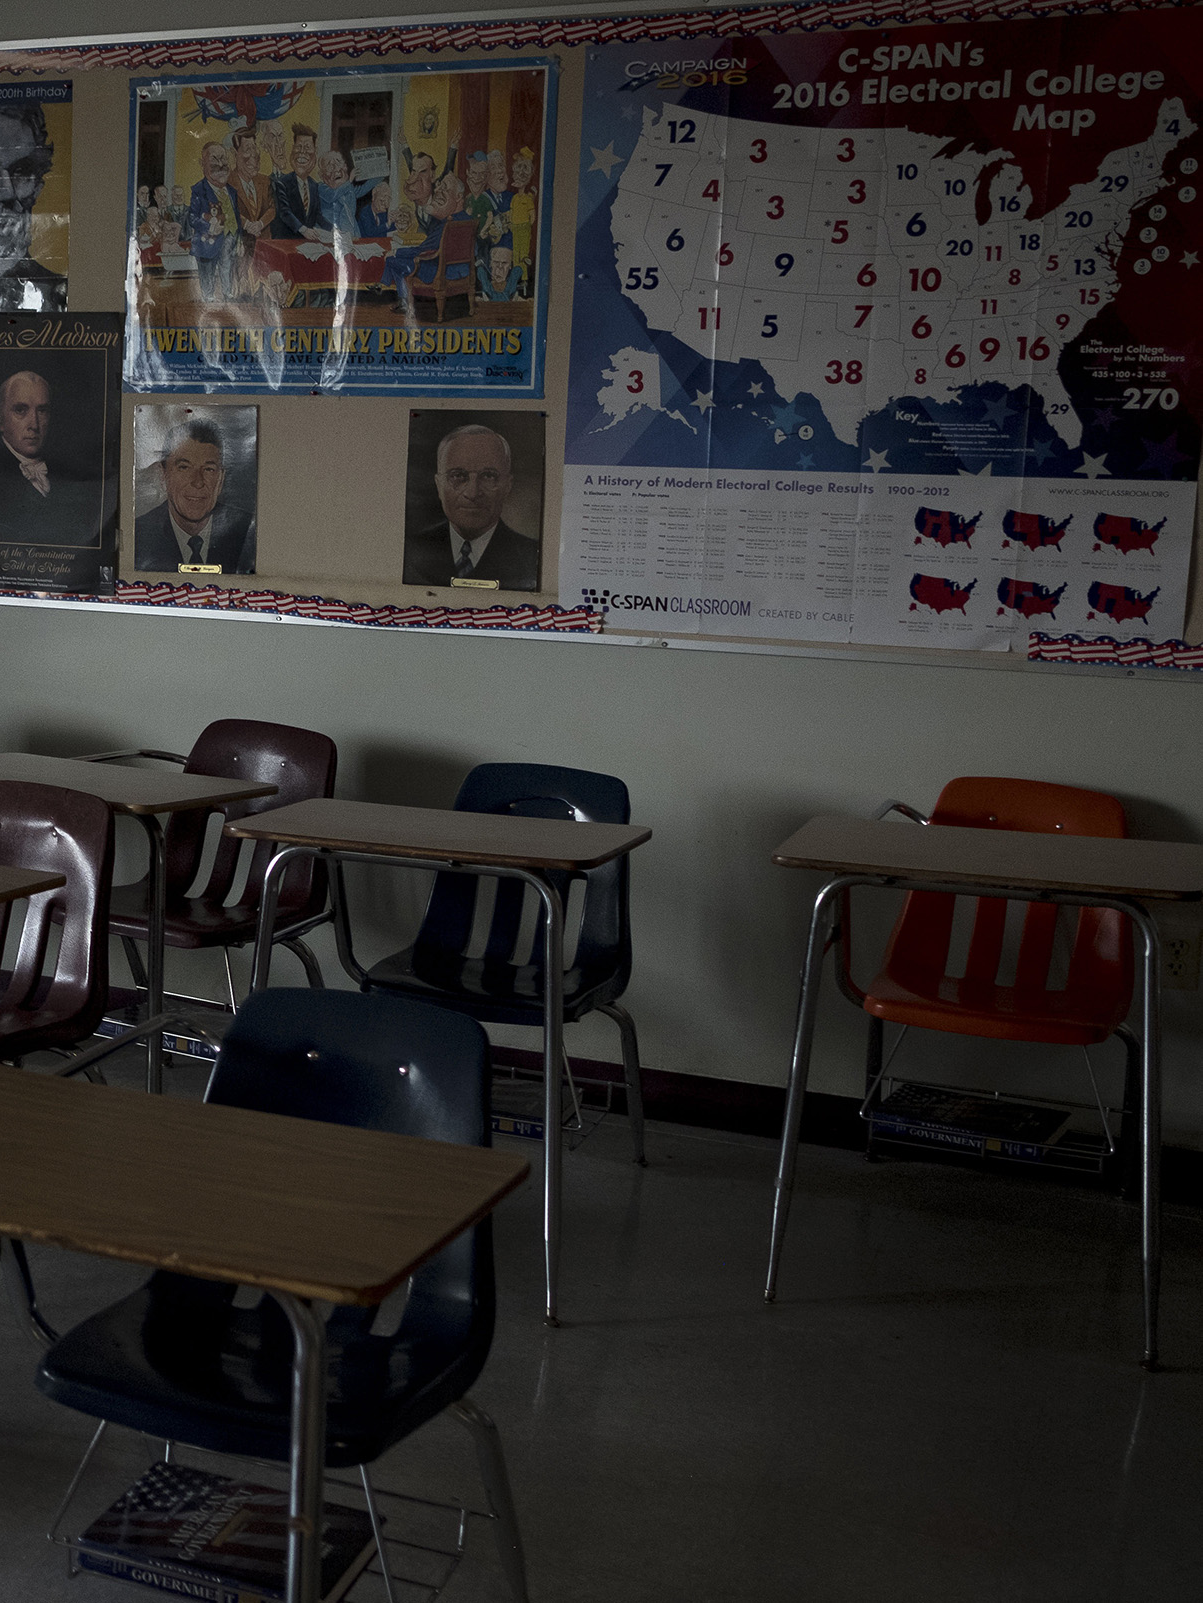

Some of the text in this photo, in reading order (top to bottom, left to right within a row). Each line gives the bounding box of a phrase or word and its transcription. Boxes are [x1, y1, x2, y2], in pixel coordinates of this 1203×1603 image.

[625, 57, 748, 78] CAMPAIGN
[837, 40, 985, 73] C-SPAN's
[657, 69, 748, 89] 2016
[772, 64, 1165, 109] 2016 Electoral College
[25, 86, 68, 99] Birthday
[667, 119, 696, 144] 12
[1012, 103, 1096, 137] Map
[1165, 119, 1180, 136] 4
[749, 138, 768, 163] 3
[836, 138, 856, 163] 3
[655, 163, 673, 187] 7
[896, 163, 919, 180] 10
[702, 179, 721, 201] 4
[847, 179, 866, 204] 3
[944, 179, 966, 195] 10
[1100, 175, 1129, 193] 29
[766, 195, 784, 220] 3
[998, 196, 1021, 212] 16
[906, 212, 927, 237] 6
[1064, 211, 1093, 228] 20
[666, 228, 685, 252] 6
[831, 220, 849, 244] 5
[1019, 233, 1041, 250] 18
[715, 242, 734, 266] 6
[946, 239, 973, 256] 20
[985, 245, 1002, 261] 11
[775, 253, 794, 277] 9
[1046, 255, 1059, 271] 5
[1074, 258, 1096, 275] 13
[625, 267, 659, 290] 55
[857, 263, 877, 287] 6
[909, 267, 942, 292] 10
[1008, 269, 1021, 285] 8
[981, 299, 998, 315] 11
[1079, 288, 1100, 305] 15
[698, 307, 721, 330] 11
[761, 315, 778, 338] 5
[853, 305, 874, 328] 7
[911, 315, 932, 339] 6
[1056, 314, 1070, 330] 9
[15, 318, 119, 349] Madison
[144, 327, 265, 355] TWENTIETH
[379, 327, 522, 355] PRESIDENTS
[197, 354, 238, 363] CLD
[317, 354, 375, 364] CATED
[379, 356, 388, 364] A
[391, 355, 447, 364] NATION?
[945, 344, 966, 369] 6
[979, 337, 1001, 362] 9
[1016, 336, 1050, 361] 16
[1079, 344, 1165, 355] Electoral College
[1138, 353, 1186, 362] Numbers
[626, 370, 644, 393] 3
[824, 360, 863, 385] 38
[914, 368, 927, 384] 8
[1050, 403, 1070, 415] 29
[1122, 387, 1180, 410] 270
[895, 410, 920, 423] Key
[584, 475, 594, 485] A
[597, 475, 643, 489] History
[647, 476, 661, 487] of
[663, 477, 713, 489] Modern
[716, 478, 770, 491] Electoral
[774, 480, 823, 495] College
[828, 482, 874, 494] Results
[1048, 488, 1170, 498] WWW.C-SPANCLASSROOM.ORG
[0, 547, 11, 558] of
[11, 546, 23, 557] the
[25, 546, 76, 561] Constitution
[1, 559, 25, 572] Bill
[26, 562, 37, 573] of
[37, 562, 72, 577] Rights
[610, 594, 855, 622] C-SPAN CLASSROOM CREATED BY CABLE
[909, 1127, 982, 1149] GOVERNMENT
[178, 1488, 254, 1562] GOVERNMENT
[130, 1568, 237, 1603] GOVERNMET
